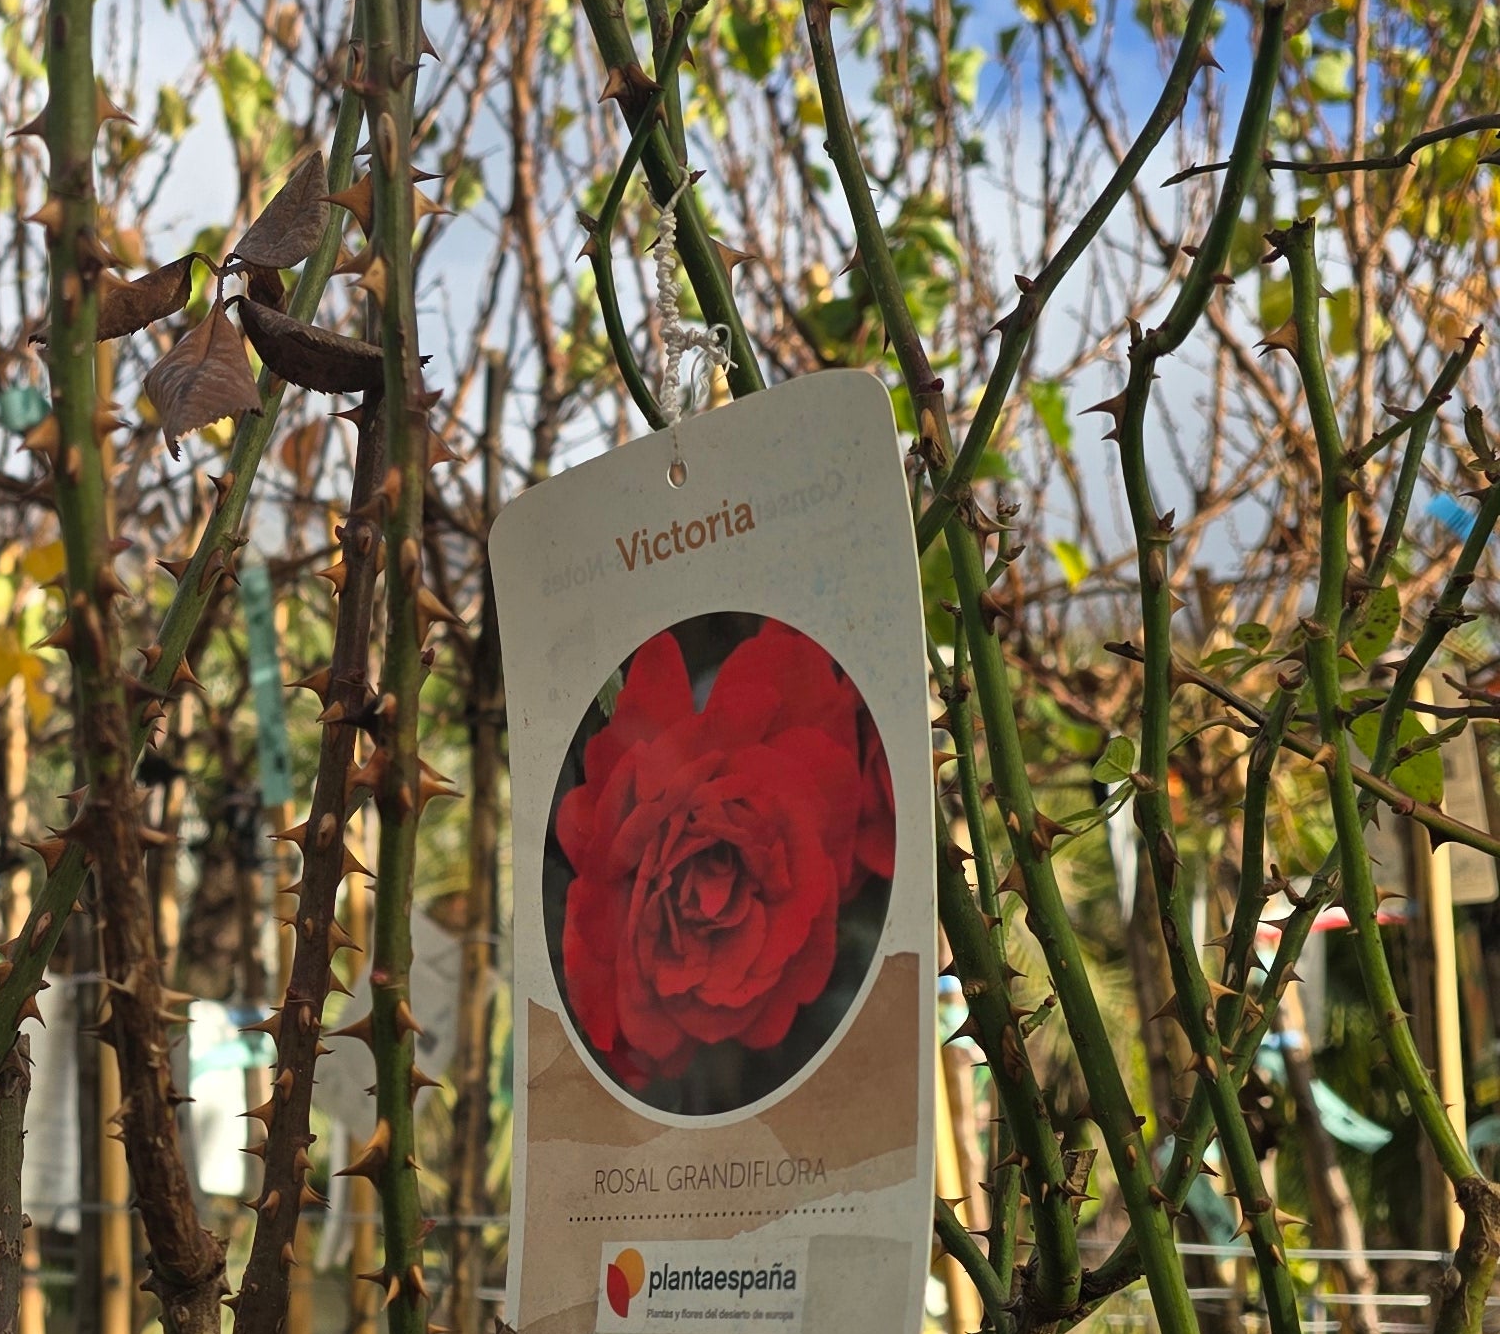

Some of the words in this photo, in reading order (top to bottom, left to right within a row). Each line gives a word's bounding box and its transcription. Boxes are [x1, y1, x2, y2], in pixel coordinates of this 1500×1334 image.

[615, 499, 756, 572] Victoria
[595, 1168, 660, 1194] ROSAL
[667, 1158, 827, 1191] GRANDIFLORA
[648, 1262, 796, 1298] plantaespaña
